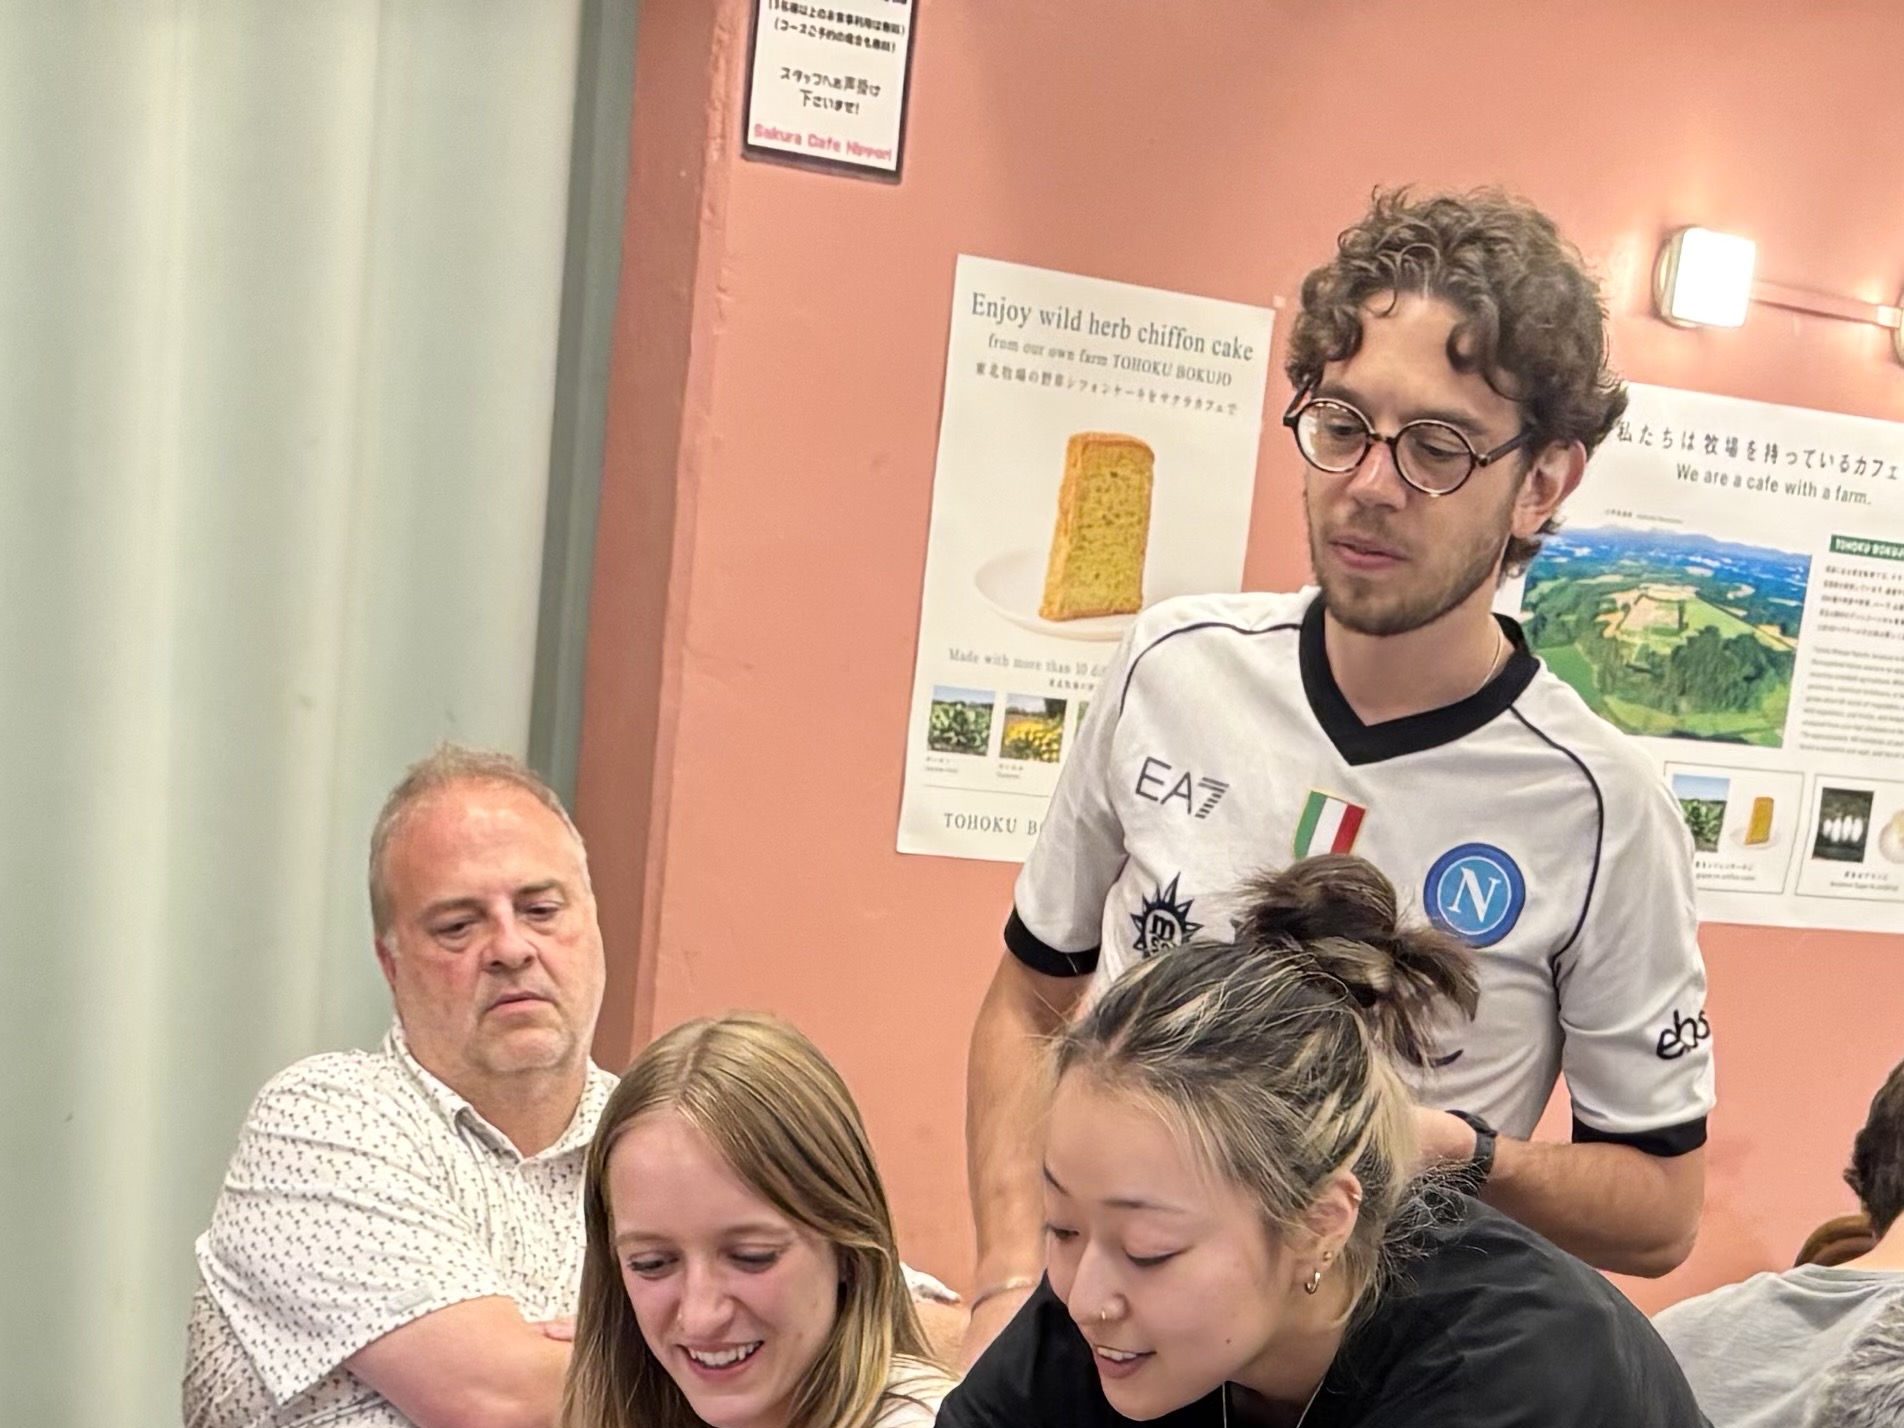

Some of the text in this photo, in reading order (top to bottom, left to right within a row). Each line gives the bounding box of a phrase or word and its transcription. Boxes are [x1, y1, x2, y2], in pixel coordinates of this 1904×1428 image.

[754, 123, 802, 146] Sakura
[807, 133, 841, 152] Cafe
[971, 292, 1254, 363] Enjoy wild herb chiffon cake
[988, 333, 1232, 388] from our own farm TOHOKU BOKUJO
[1676, 463, 1872, 507] We are a cafe with a farm.
[949, 648, 979, 664] Made
[984, 651, 1009, 668] with
[1013, 656, 1042, 671] more
[1046, 656, 1071, 675] than
[1135, 756, 1229, 821] EA7
[944, 812, 1017, 833] TOHOKU
[1448, 867, 1501, 923] N
